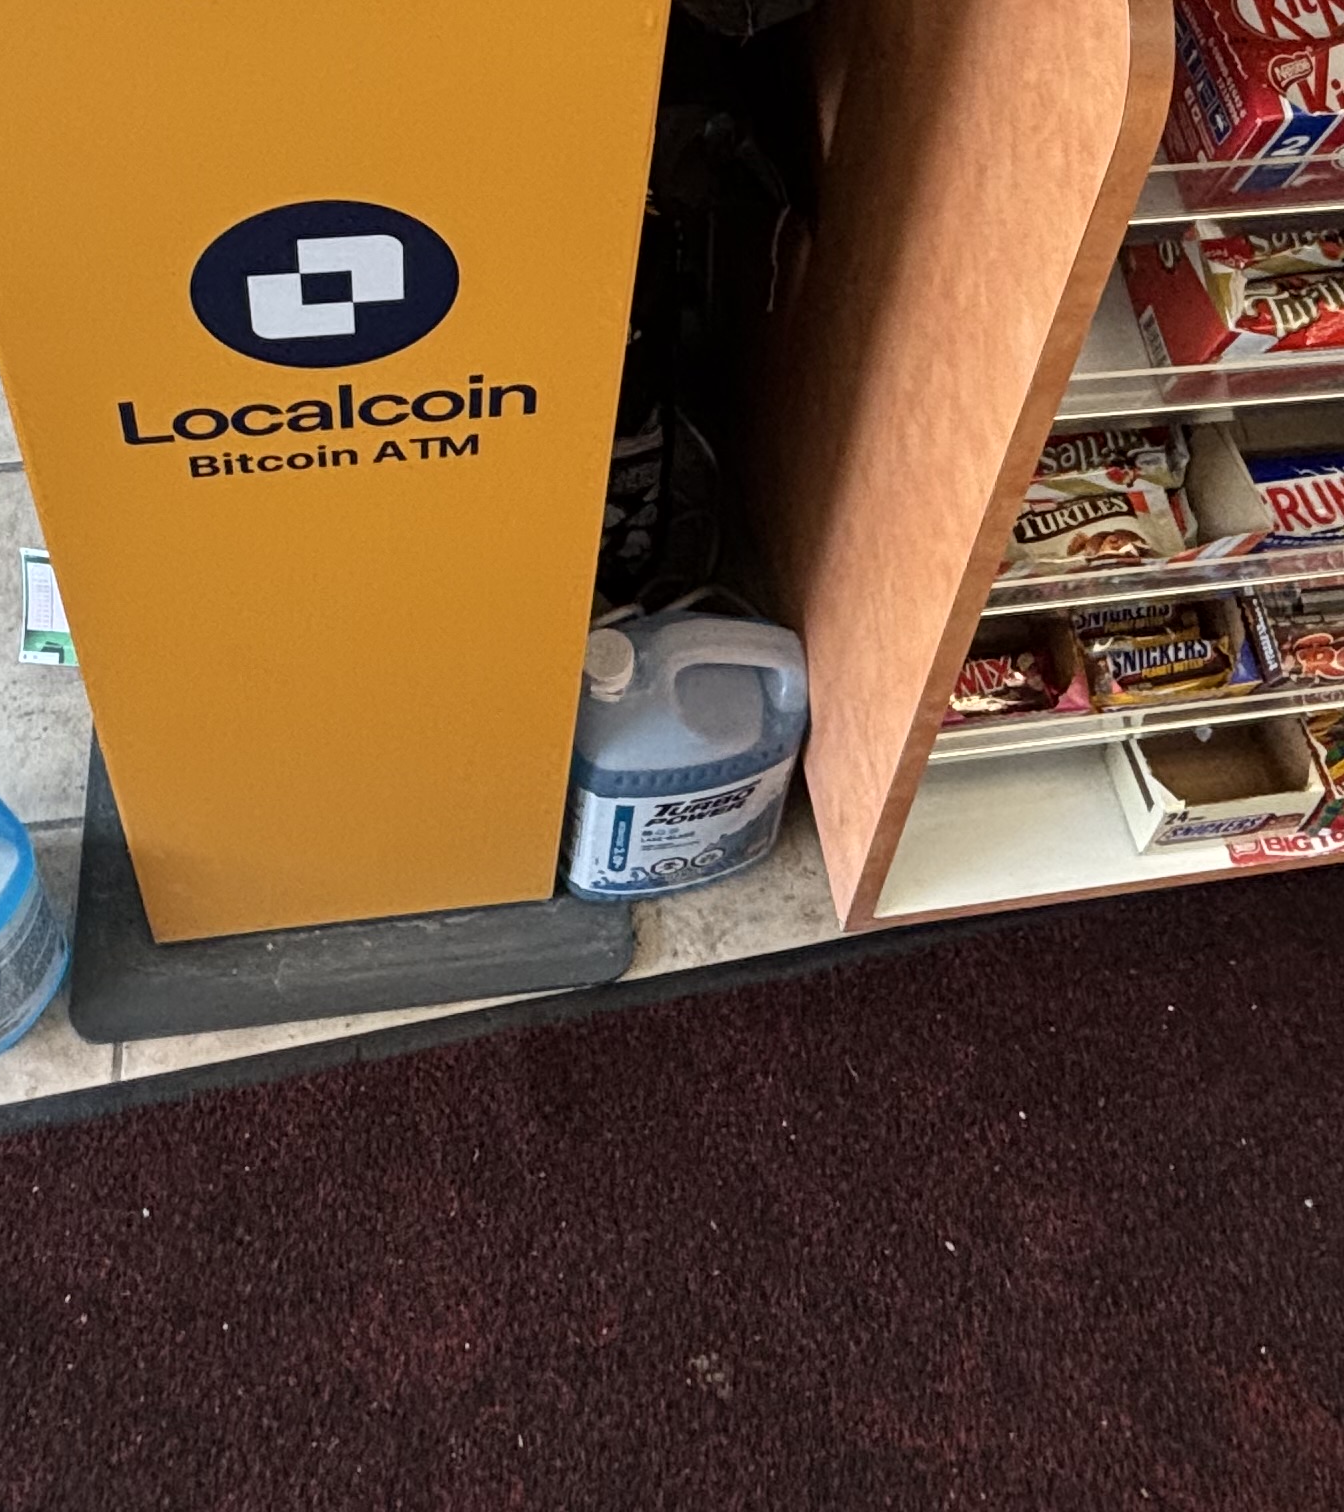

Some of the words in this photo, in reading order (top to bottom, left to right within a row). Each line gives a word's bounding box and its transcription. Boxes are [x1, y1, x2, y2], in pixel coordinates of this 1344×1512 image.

[1271, 136, 1311, 157] 2
[118, 374, 538, 445] Localcoin
[188, 444, 358, 478] Bitcoin
[373, 433, 479, 464] ATM
[1017, 495, 1129, 540] TURTLES
[1112, 638, 1208, 677] SNICKERS
[644, 799, 748, 827] POWER
[652, 779, 762, 819] TURBO
[1166, 812, 1189, 825] 24
[1169, 815, 1259, 836] SNICKERS
[1266, 832, 1311, 853] BIG
